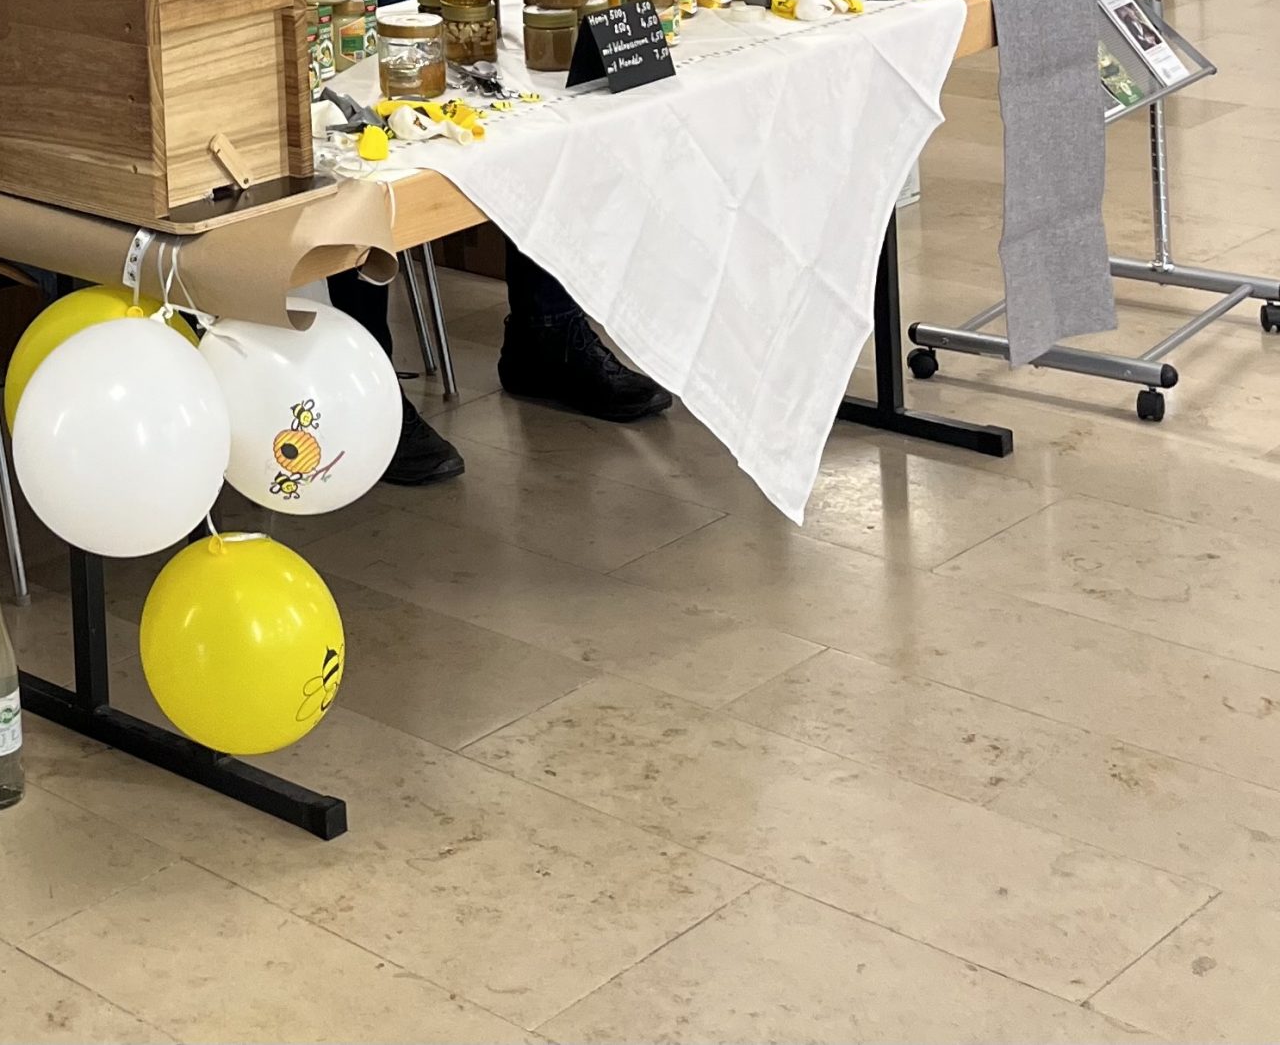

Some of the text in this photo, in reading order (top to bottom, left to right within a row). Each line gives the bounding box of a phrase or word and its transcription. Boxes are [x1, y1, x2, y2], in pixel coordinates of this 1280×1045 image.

[588, 14, 609, 26] Honig
[602, 44, 613, 56] mit
[607, 61, 618, 74] mit
